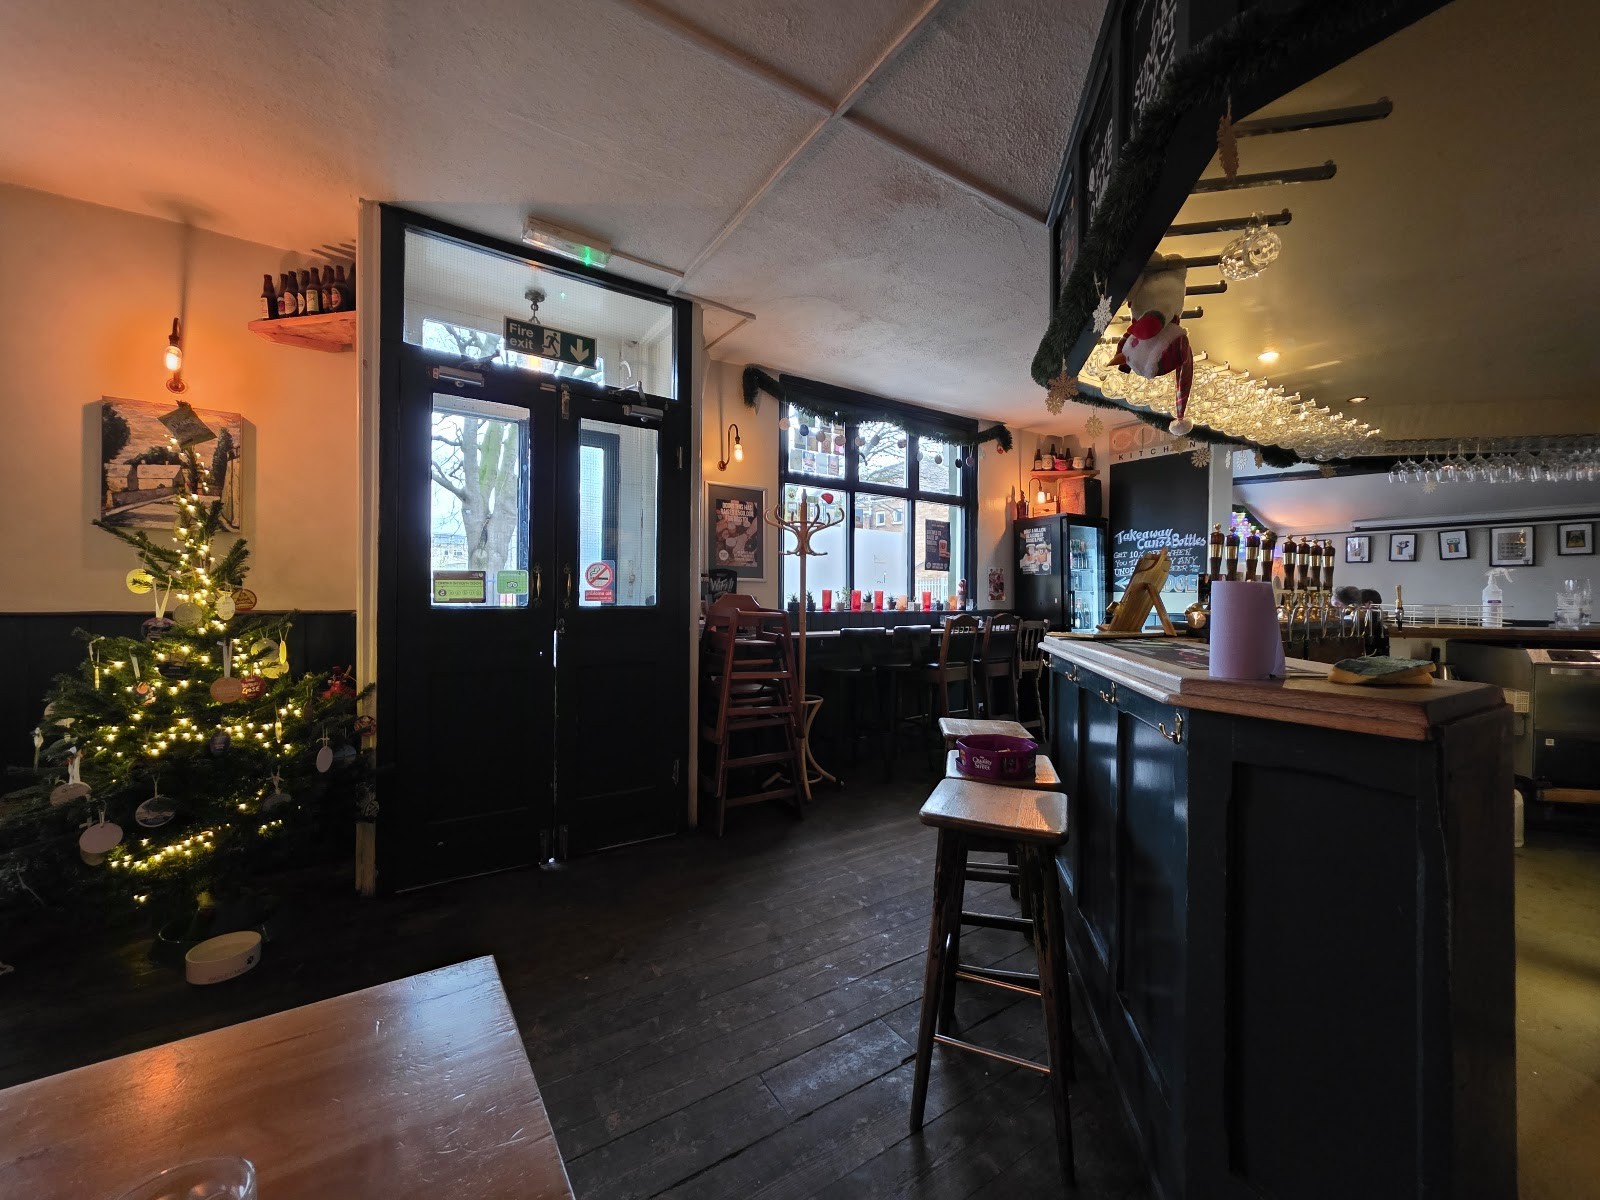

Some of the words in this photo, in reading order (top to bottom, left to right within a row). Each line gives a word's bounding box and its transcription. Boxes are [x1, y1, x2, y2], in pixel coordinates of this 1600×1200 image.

[509, 322, 534, 338] Fire
[509, 336, 534, 350] exit
[1118, 441, 1196, 461] KITCHN
[1114, 528, 1174, 544] Takeaway
[1137, 538, 1165, 550] Cans
[1172, 533, 1207, 549] Bottles
[972, 757, 992, 765] Quality
